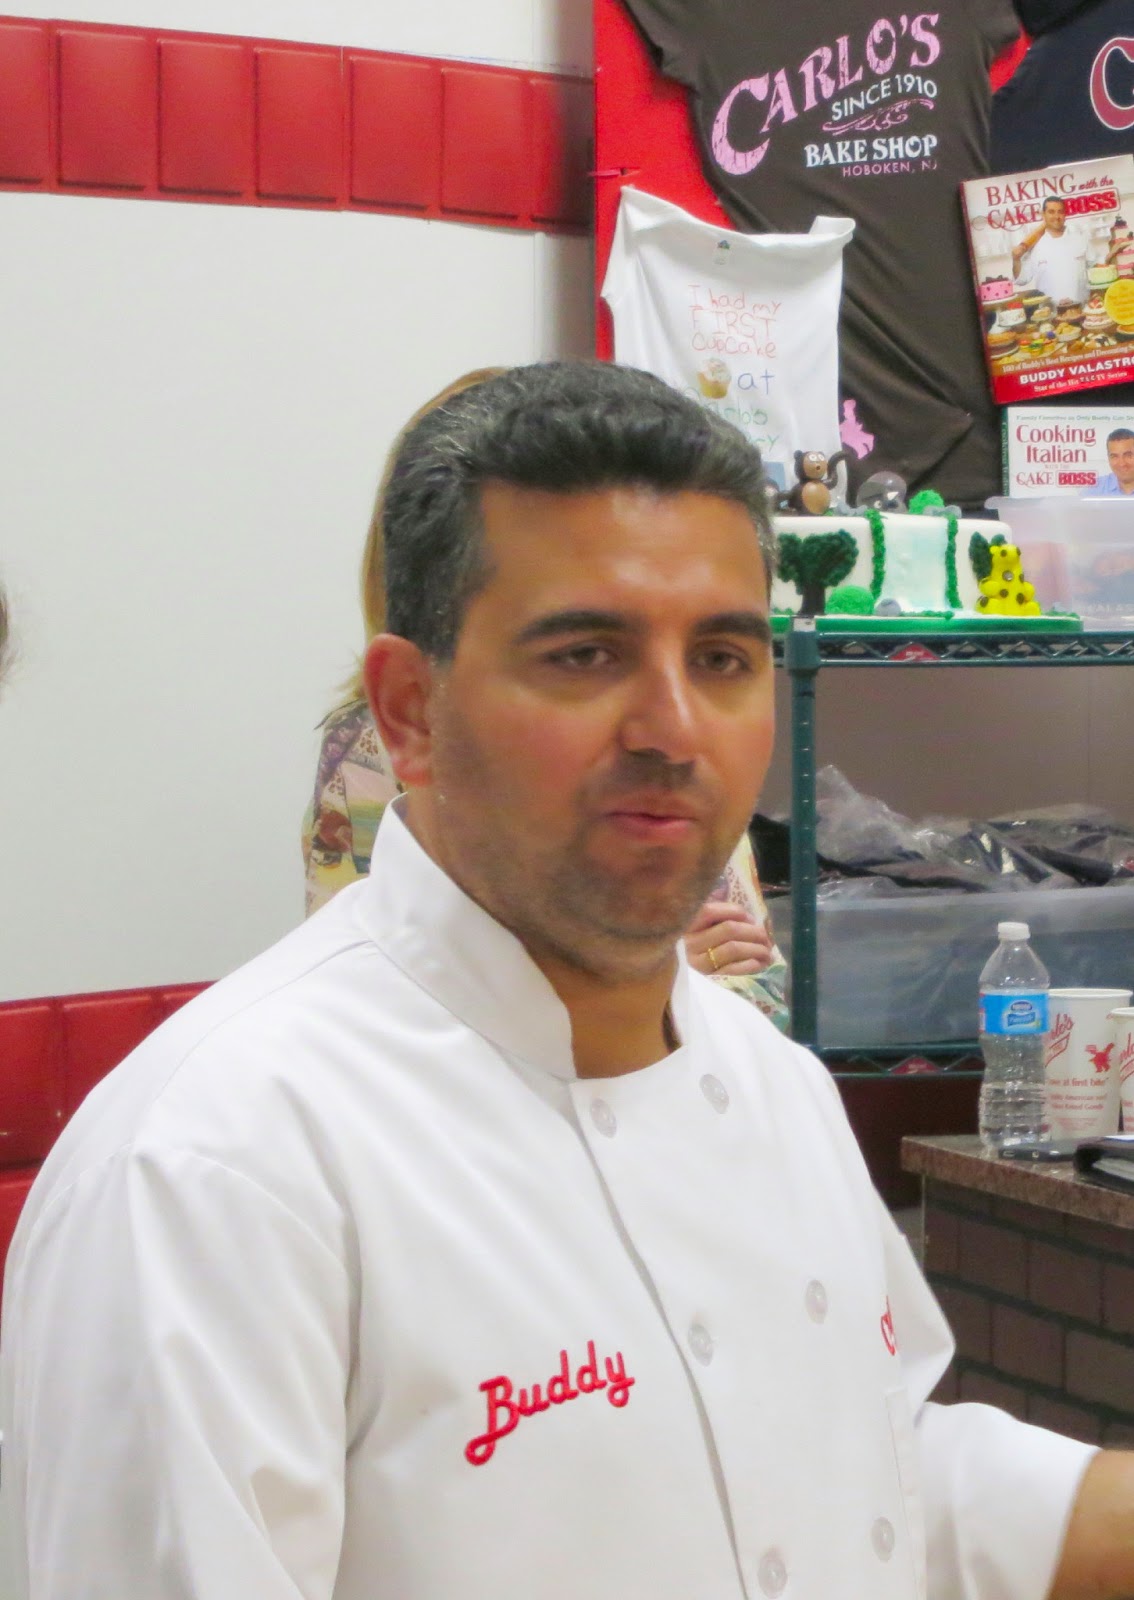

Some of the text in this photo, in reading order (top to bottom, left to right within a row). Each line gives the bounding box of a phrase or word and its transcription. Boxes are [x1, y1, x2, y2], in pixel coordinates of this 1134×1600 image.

[711, 13, 941, 175] CARLO'S
[831, 74, 938, 121] SINCE 1910
[803, 134, 938, 168] BAKE SHOP
[842, 161, 916, 177] HOBOKEN,
[985, 174, 1114, 206] BAKING with the
[987, 202, 1044, 230] CAKE
[708, 287, 746, 310] had
[752, 300, 782, 316] my
[691, 308, 777, 342] FIRST
[737, 368, 775, 395] at
[1019, 368, 1065, 385] BUDDY
[1016, 424, 1097, 447] Cooking
[1026, 445, 1087, 463] Italian
[1016, 471, 1055, 488] CAKE
[1058, 472, 1097, 486] BOSS
[464, 1340, 635, 1466] Buddy
